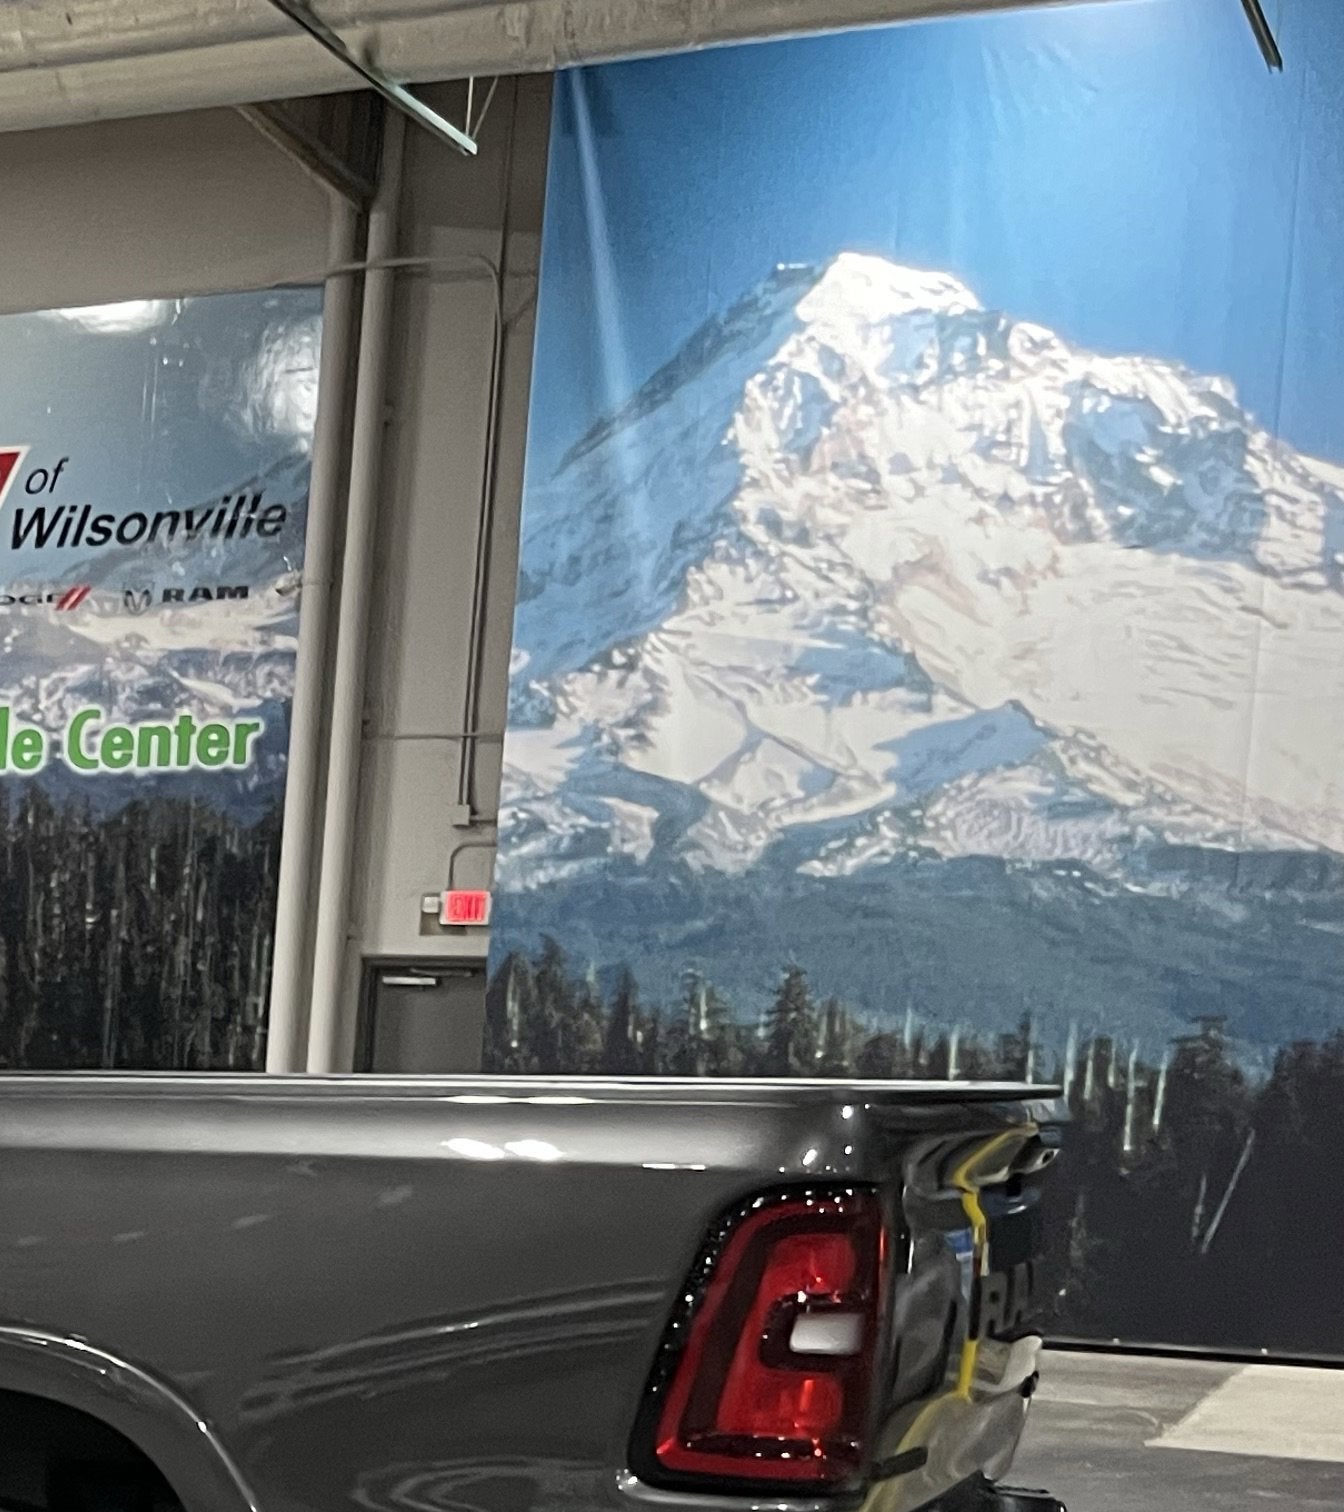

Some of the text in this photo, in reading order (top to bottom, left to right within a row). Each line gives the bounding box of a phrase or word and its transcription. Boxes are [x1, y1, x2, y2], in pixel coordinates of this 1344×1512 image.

[24, 457, 69, 494] of
[11, 489, 287, 550] Wilsonville
[162, 585, 249, 603] RAM
[67, 708, 260, 770] Center
